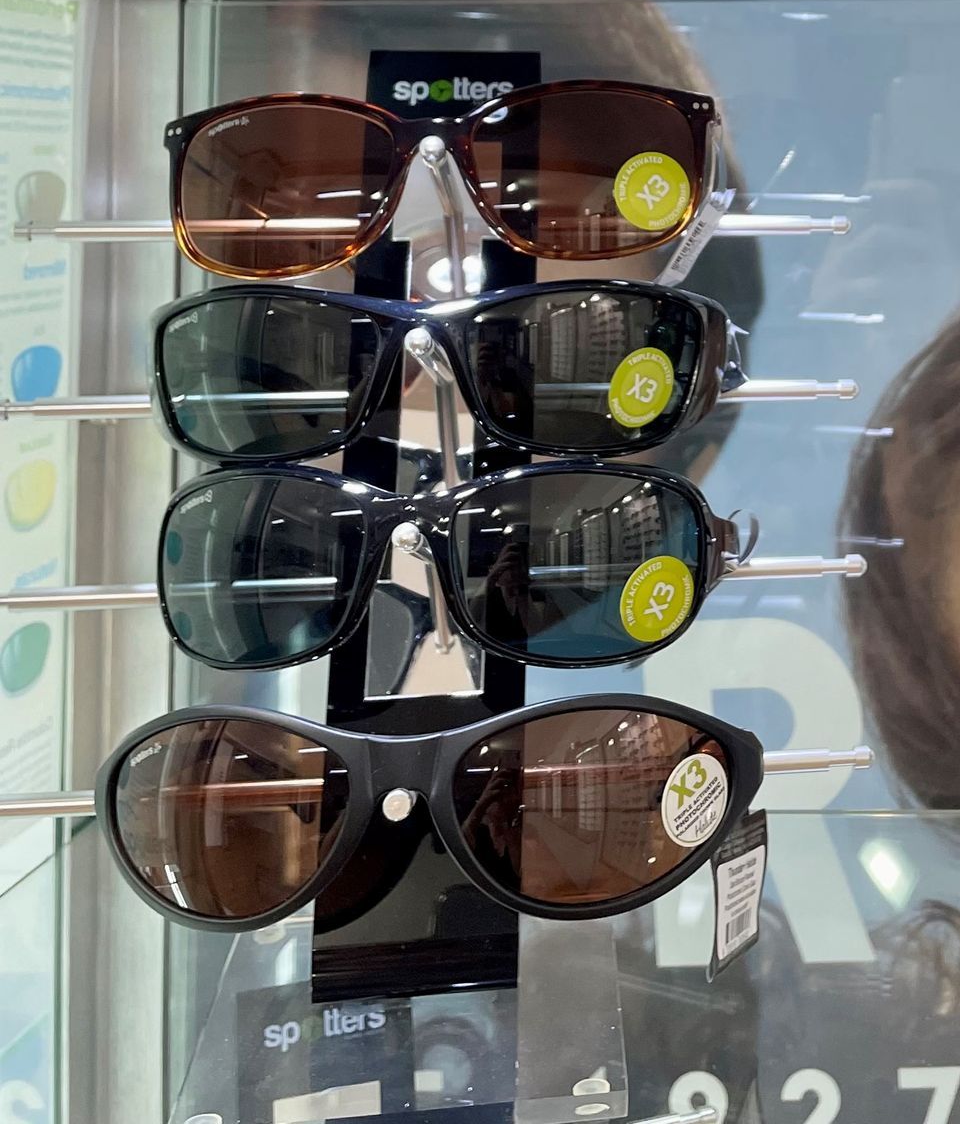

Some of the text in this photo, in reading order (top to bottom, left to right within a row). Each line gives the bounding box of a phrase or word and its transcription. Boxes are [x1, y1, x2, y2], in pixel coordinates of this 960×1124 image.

[627, 156, 663, 176] ACTIVATED
[635, 174, 671, 211] X3
[626, 373, 658, 403] X3
[625, 562, 663, 626] TRIPLE ACTIVATED
[643, 581, 675, 621] X3
[669, 759, 707, 809] X3
[673, 776, 718, 824] TRIPLE ACTIVATED
[675, 781, 722, 831] PHOTOCHROMIC
